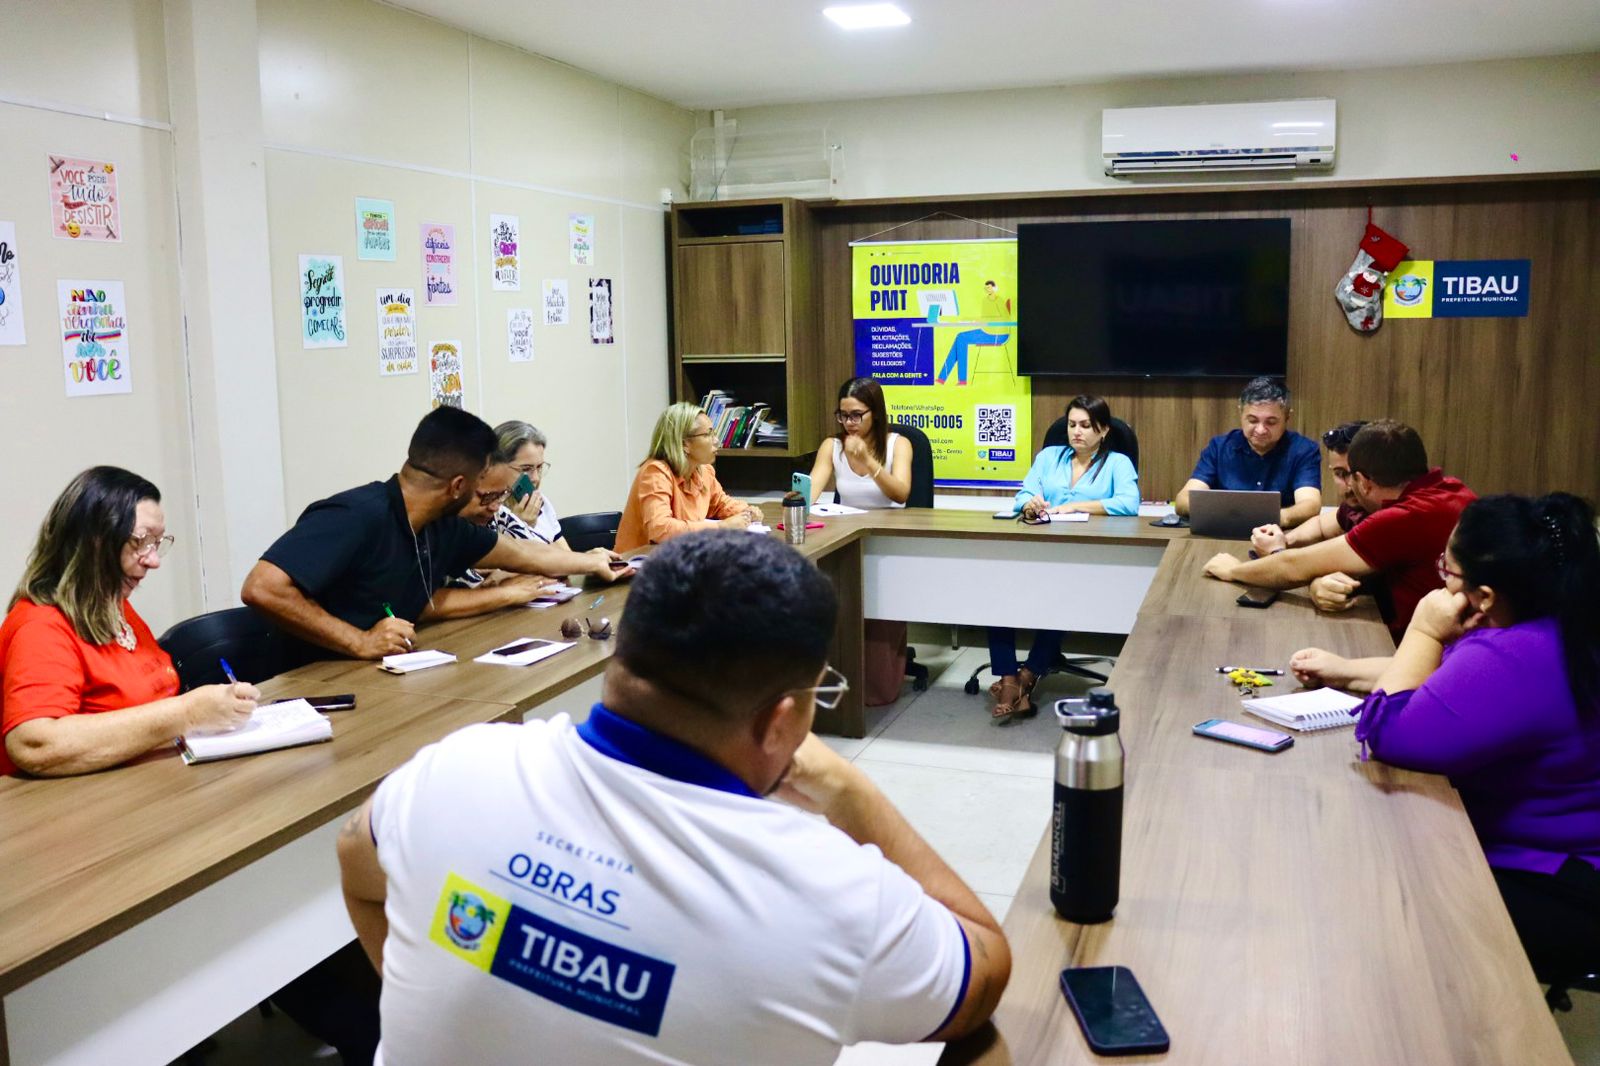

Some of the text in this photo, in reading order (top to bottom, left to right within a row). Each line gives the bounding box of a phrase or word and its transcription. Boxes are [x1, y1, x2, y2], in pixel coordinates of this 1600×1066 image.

[870, 262, 960, 286] OUVIDORIA
[1442, 276, 1519, 295] TIBAU
[870, 290, 907, 311] PMT
[897, 414, 963, 429] 98601-0005
[536, 831, 635, 875] SECRETARIA
[508, 853, 620, 915] OBRAS
[520, 924, 651, 1001] TIBAU
[576, 988, 642, 1017] MUNICIPAL
